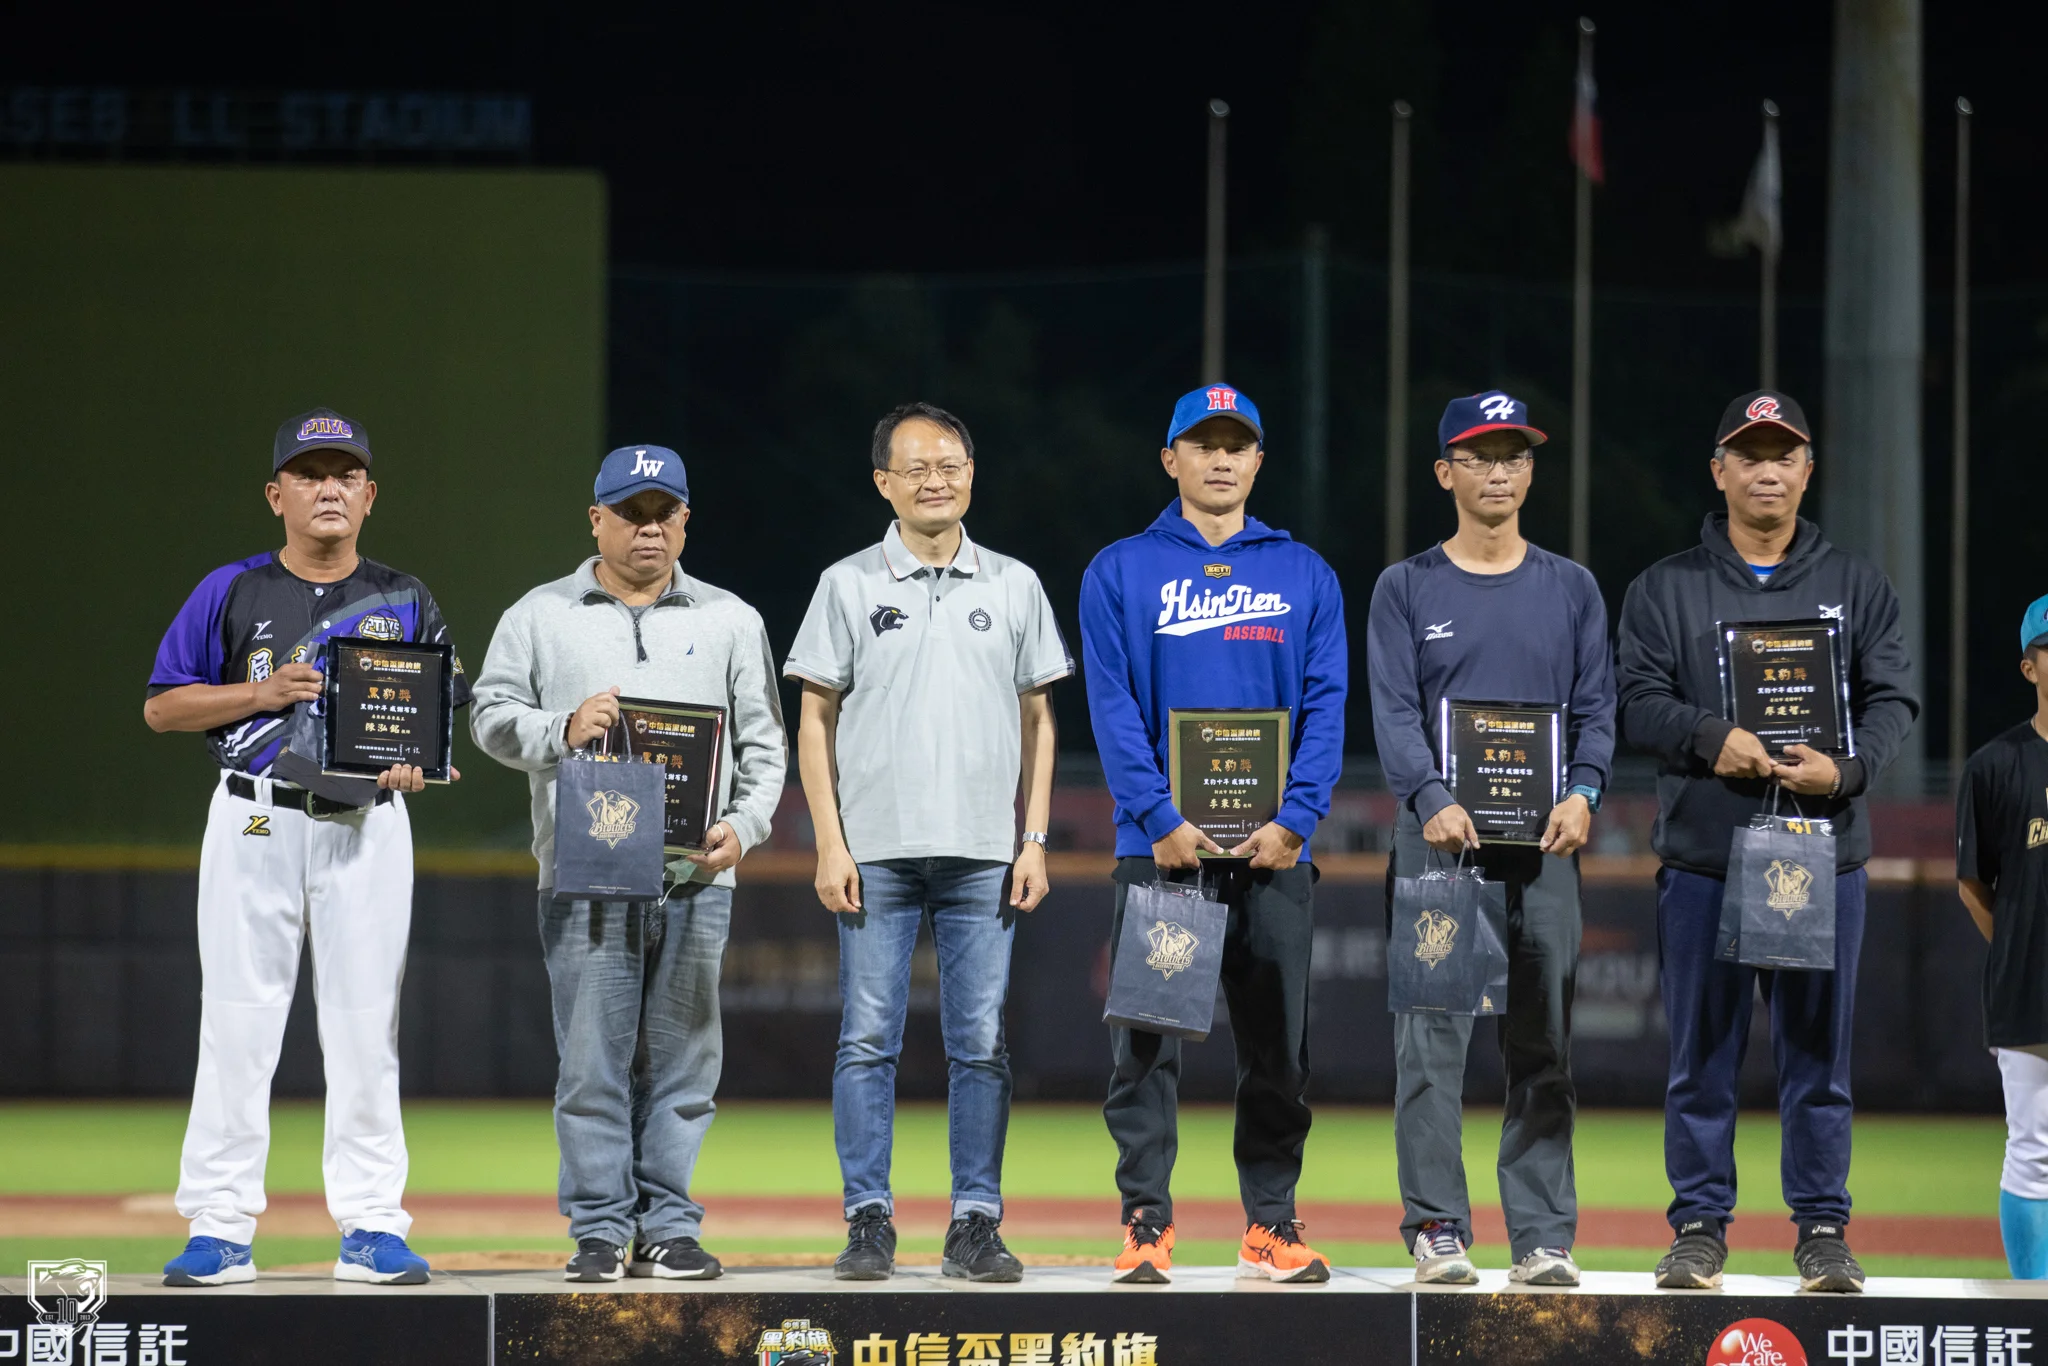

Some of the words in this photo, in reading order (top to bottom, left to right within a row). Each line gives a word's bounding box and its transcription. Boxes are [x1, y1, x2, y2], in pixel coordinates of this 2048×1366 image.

[1479, 395, 1515, 420] H
[1157, 579, 1291, 627] HsinTien
[1223, 625, 1285, 643] BASEBALL
[1763, 667, 1807, 682] 黑豹獎
[367, 686, 412, 702] 黑豹獎
[1209, 758, 1252, 773] 黑豹獎
[1483, 748, 1527, 764] 黑豹獎
[1150, 949, 1192, 965] Brothers
[761, 1331, 829, 1351] 黑豹旗
[852, 1332, 1158, 1366] 中信盃黑豹旗
[1739, 1332, 1772, 1352] We
[1827, 1324, 2034, 1366] 中國信託
